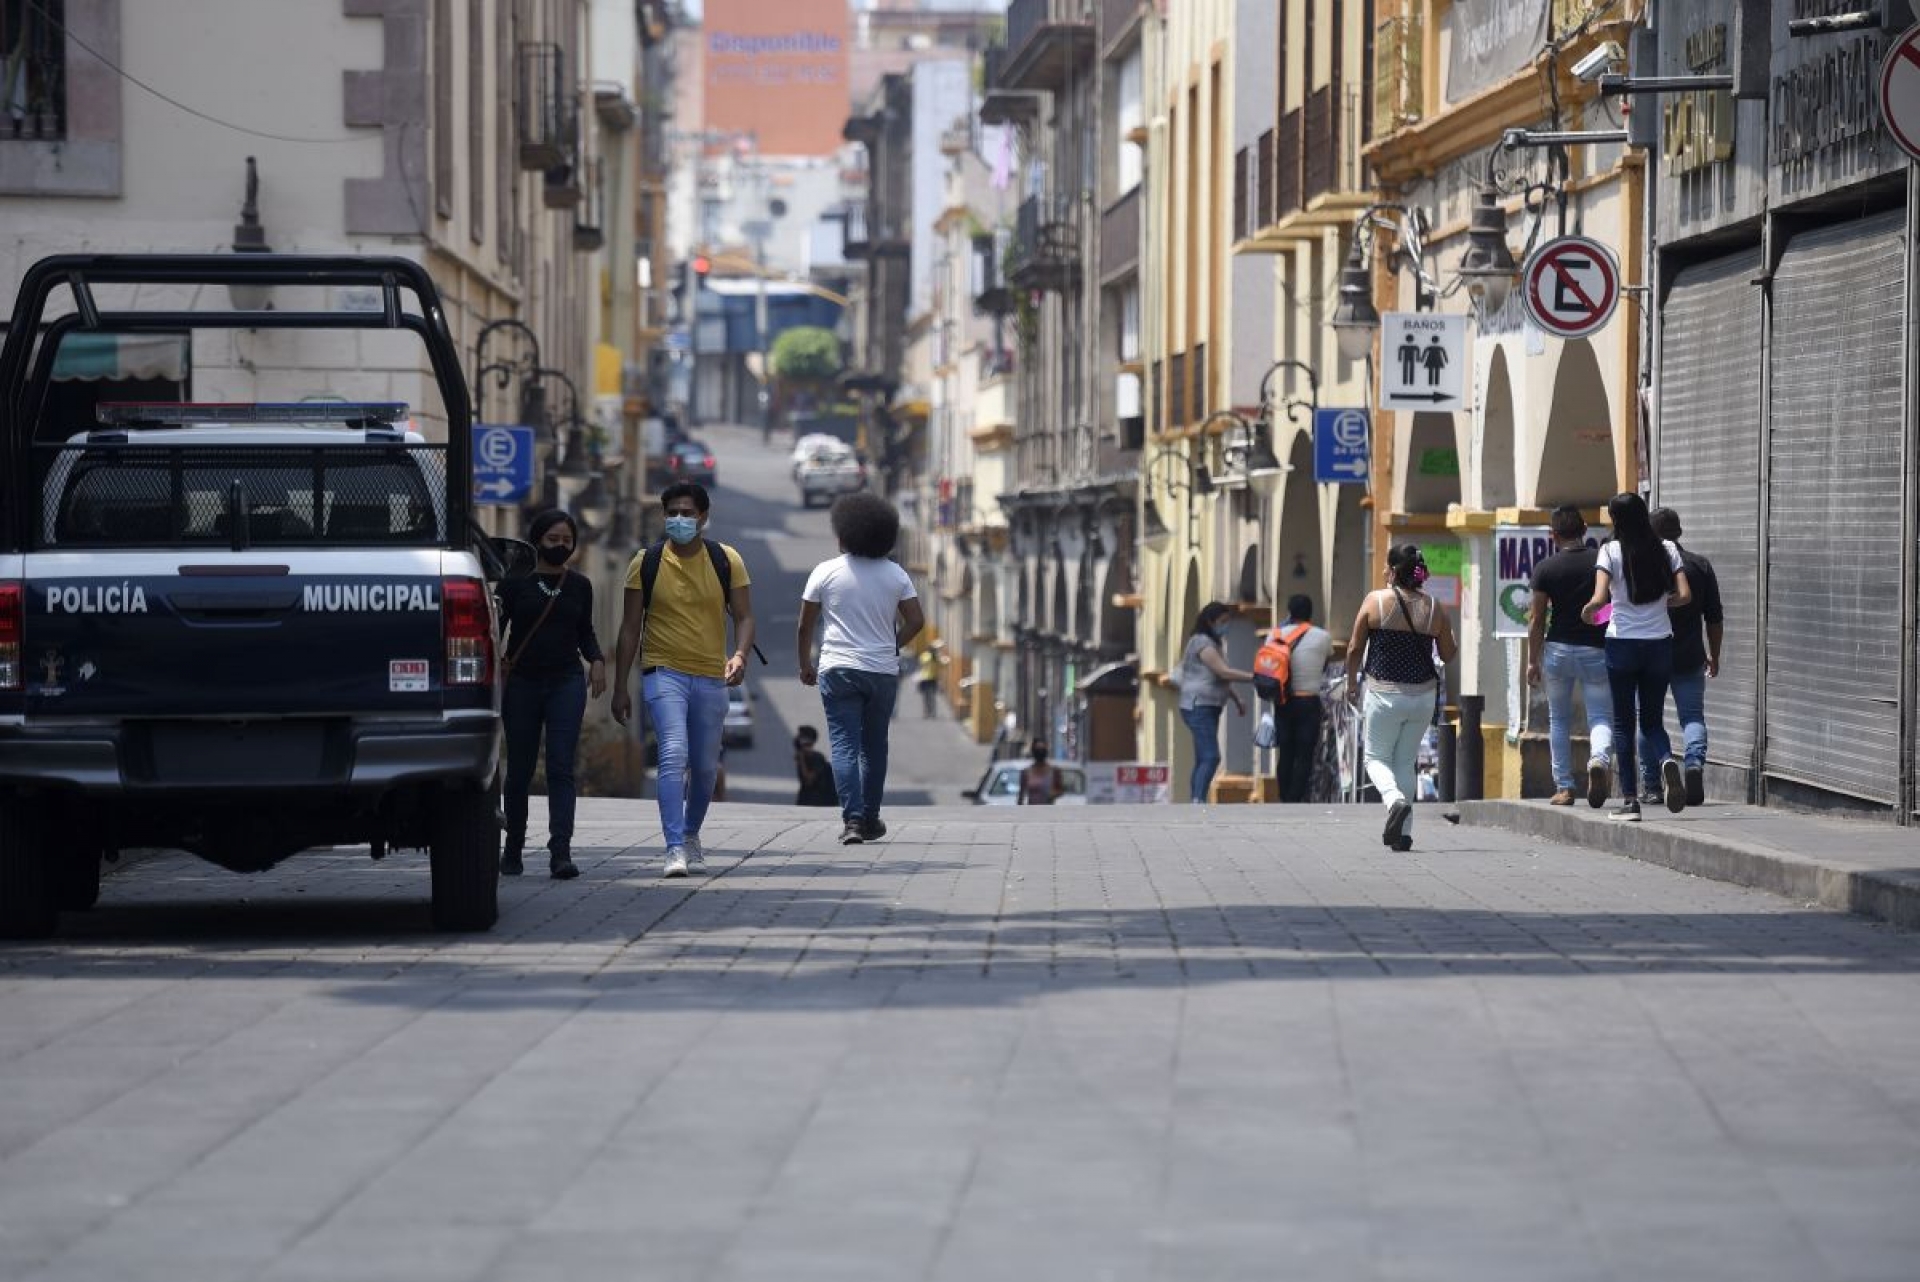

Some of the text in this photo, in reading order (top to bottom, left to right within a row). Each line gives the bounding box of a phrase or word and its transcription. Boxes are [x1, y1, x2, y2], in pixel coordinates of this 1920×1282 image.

[710, 31, 840, 57] Disponible
[1554, 259, 1591, 312] E
[1403, 320, 1446, 330] BAÑOS
[47, 581, 440, 613] POLICÍA MUNICIPAL
